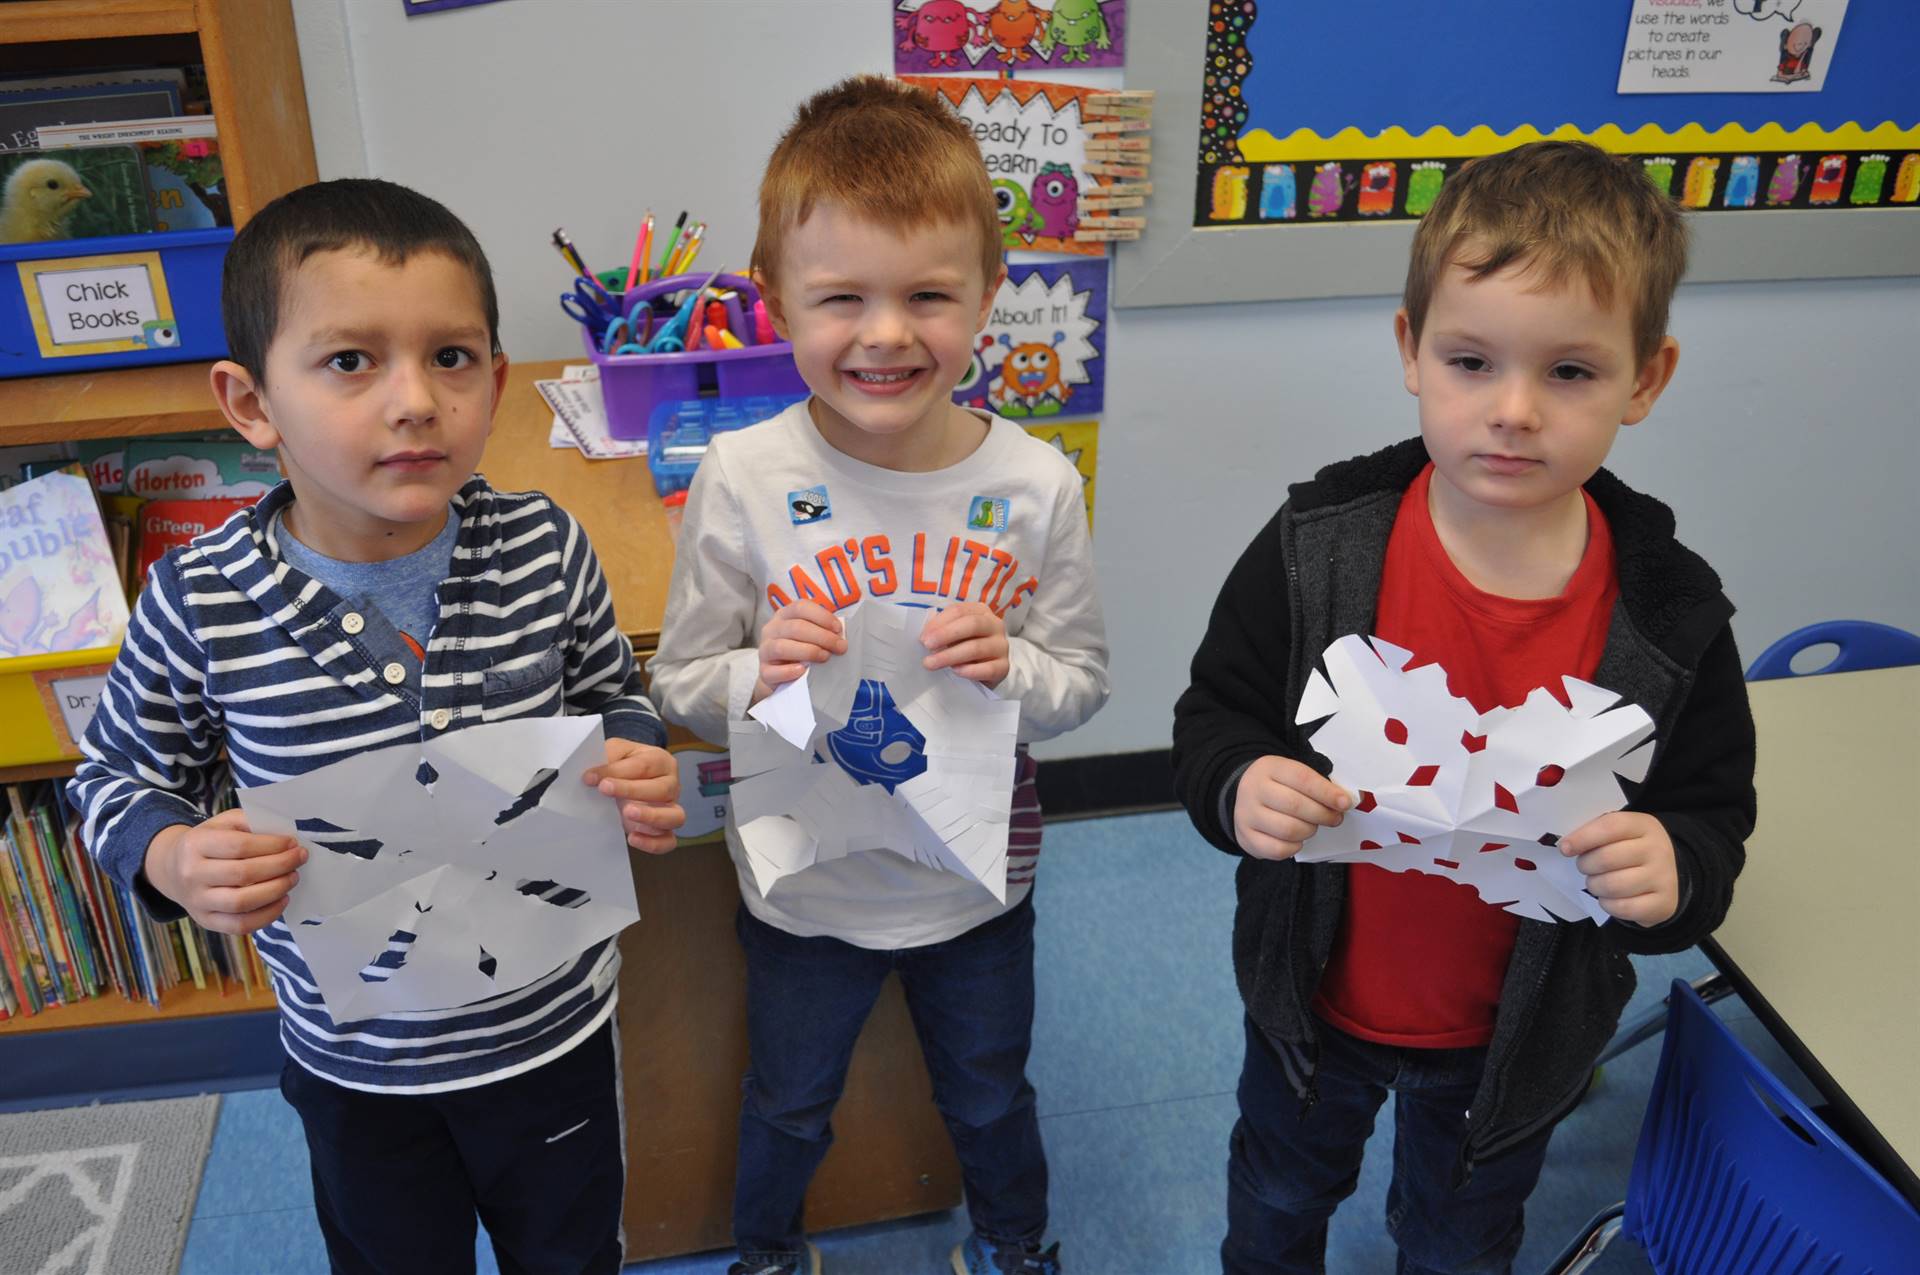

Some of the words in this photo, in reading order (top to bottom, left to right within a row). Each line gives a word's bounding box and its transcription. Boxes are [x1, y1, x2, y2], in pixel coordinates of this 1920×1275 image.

[1635, 14, 1659, 25] use
[1663, 11, 1686, 25] the
[1690, 12, 1729, 25] words
[1648, 29, 1663, 42] to
[1666, 30, 1711, 43] create
[1627, 47, 1682, 63] pictures
[1685, 48, 1696, 61] in
[1698, 49, 1723, 61] our
[1040, 123, 1068, 145] To
[66, 280, 129, 302] Chick
[68, 309, 140, 331] Books
[135, 467, 206, 493] Horton
[146, 516, 205, 536] Green
